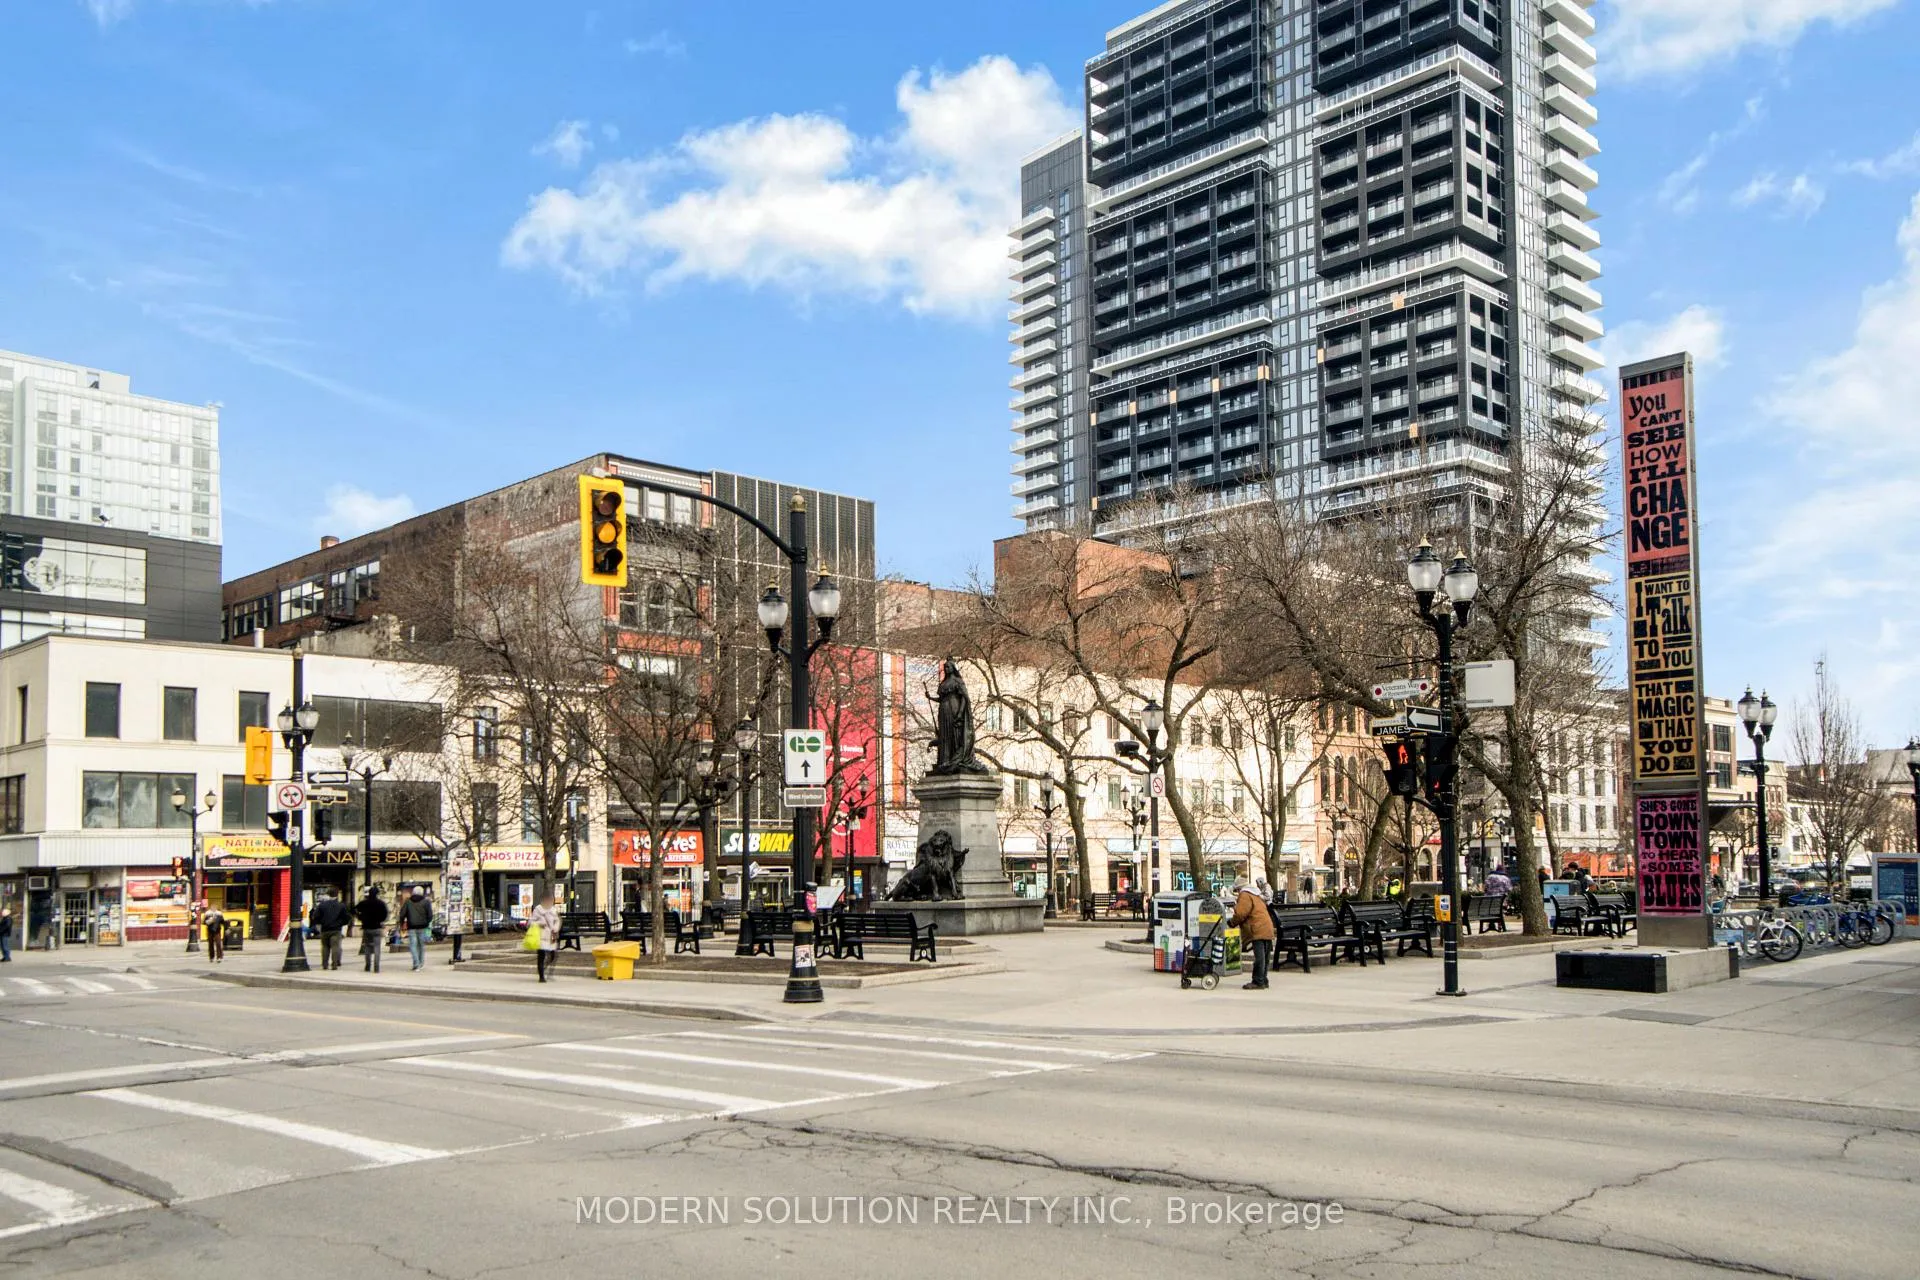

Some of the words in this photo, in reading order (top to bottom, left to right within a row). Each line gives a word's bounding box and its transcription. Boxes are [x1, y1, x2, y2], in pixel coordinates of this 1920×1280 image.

[1640, 410, 1682, 428] CAN'T
[1628, 422, 1684, 449] SEE
[1631, 443, 1682, 466] HOW
[1629, 461, 1686, 484] I'LL
[1630, 478, 1687, 518] CHA
[1631, 512, 1689, 553] NGE
[1644, 581, 1673, 596] WANT
[1677, 579, 1690, 591] TO
[1634, 638, 1659, 659] TO
[1662, 649, 1692, 669] YOU
[1635, 681, 1673, 698] THAT
[1637, 694, 1695, 720] MAGIC
[1377, 726, 1411, 736] JAMES
[1655, 717, 1695, 738] THAT
[1640, 738, 1693, 755] YOU
[1640, 756, 1670, 773] DO
[1640, 800, 1667, 813] SHE'S
[1670, 800, 1697, 812] GONE
[225, 839, 283, 847] NATINA
[1641, 831, 1697, 849] TOWN
[327, 851, 380, 863] NAIS
[385, 851, 421, 863] SPA
[1642, 851, 1656, 860] TO
[1658, 849, 1699, 861] HEAR
[1648, 862, 1693, 873] SOME
[1643, 873, 1702, 907] BLUES
